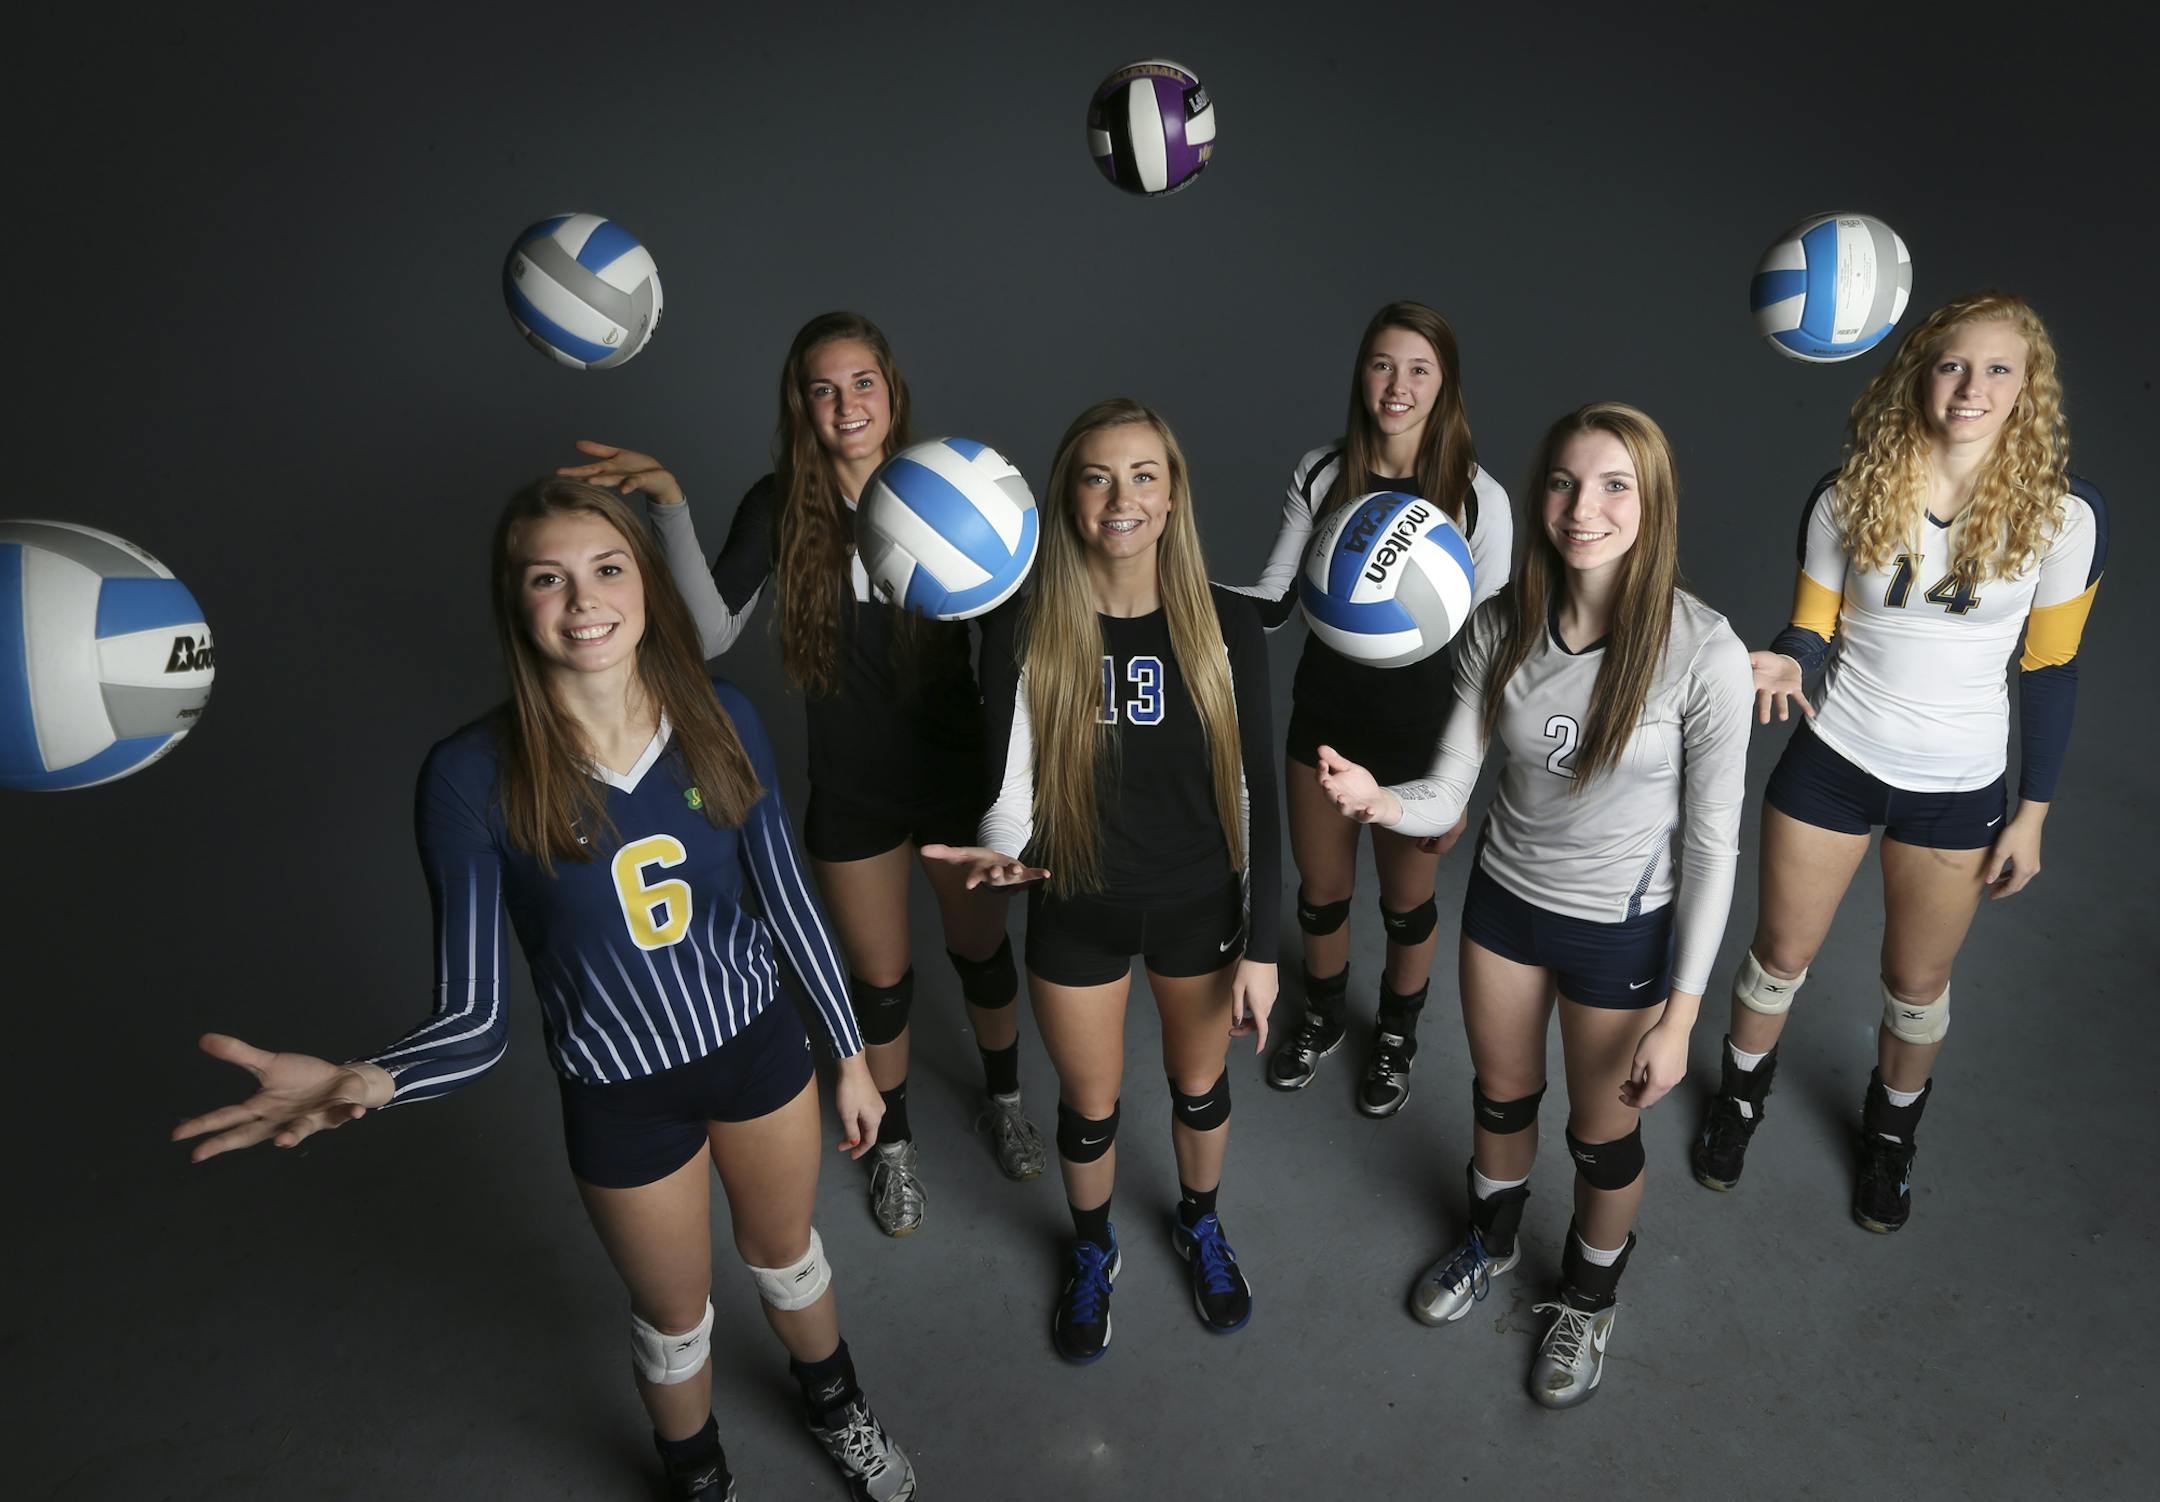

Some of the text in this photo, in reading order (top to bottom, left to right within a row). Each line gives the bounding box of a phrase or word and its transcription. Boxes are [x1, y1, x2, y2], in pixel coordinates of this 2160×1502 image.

[1343, 495, 1403, 553] NCAA
[1365, 505, 1430, 583] molten
[1884, 553, 1981, 615] 14
[1096, 655, 1165, 725] 13
[1544, 714, 1579, 779] 2
[611, 833, 693, 951] 6
